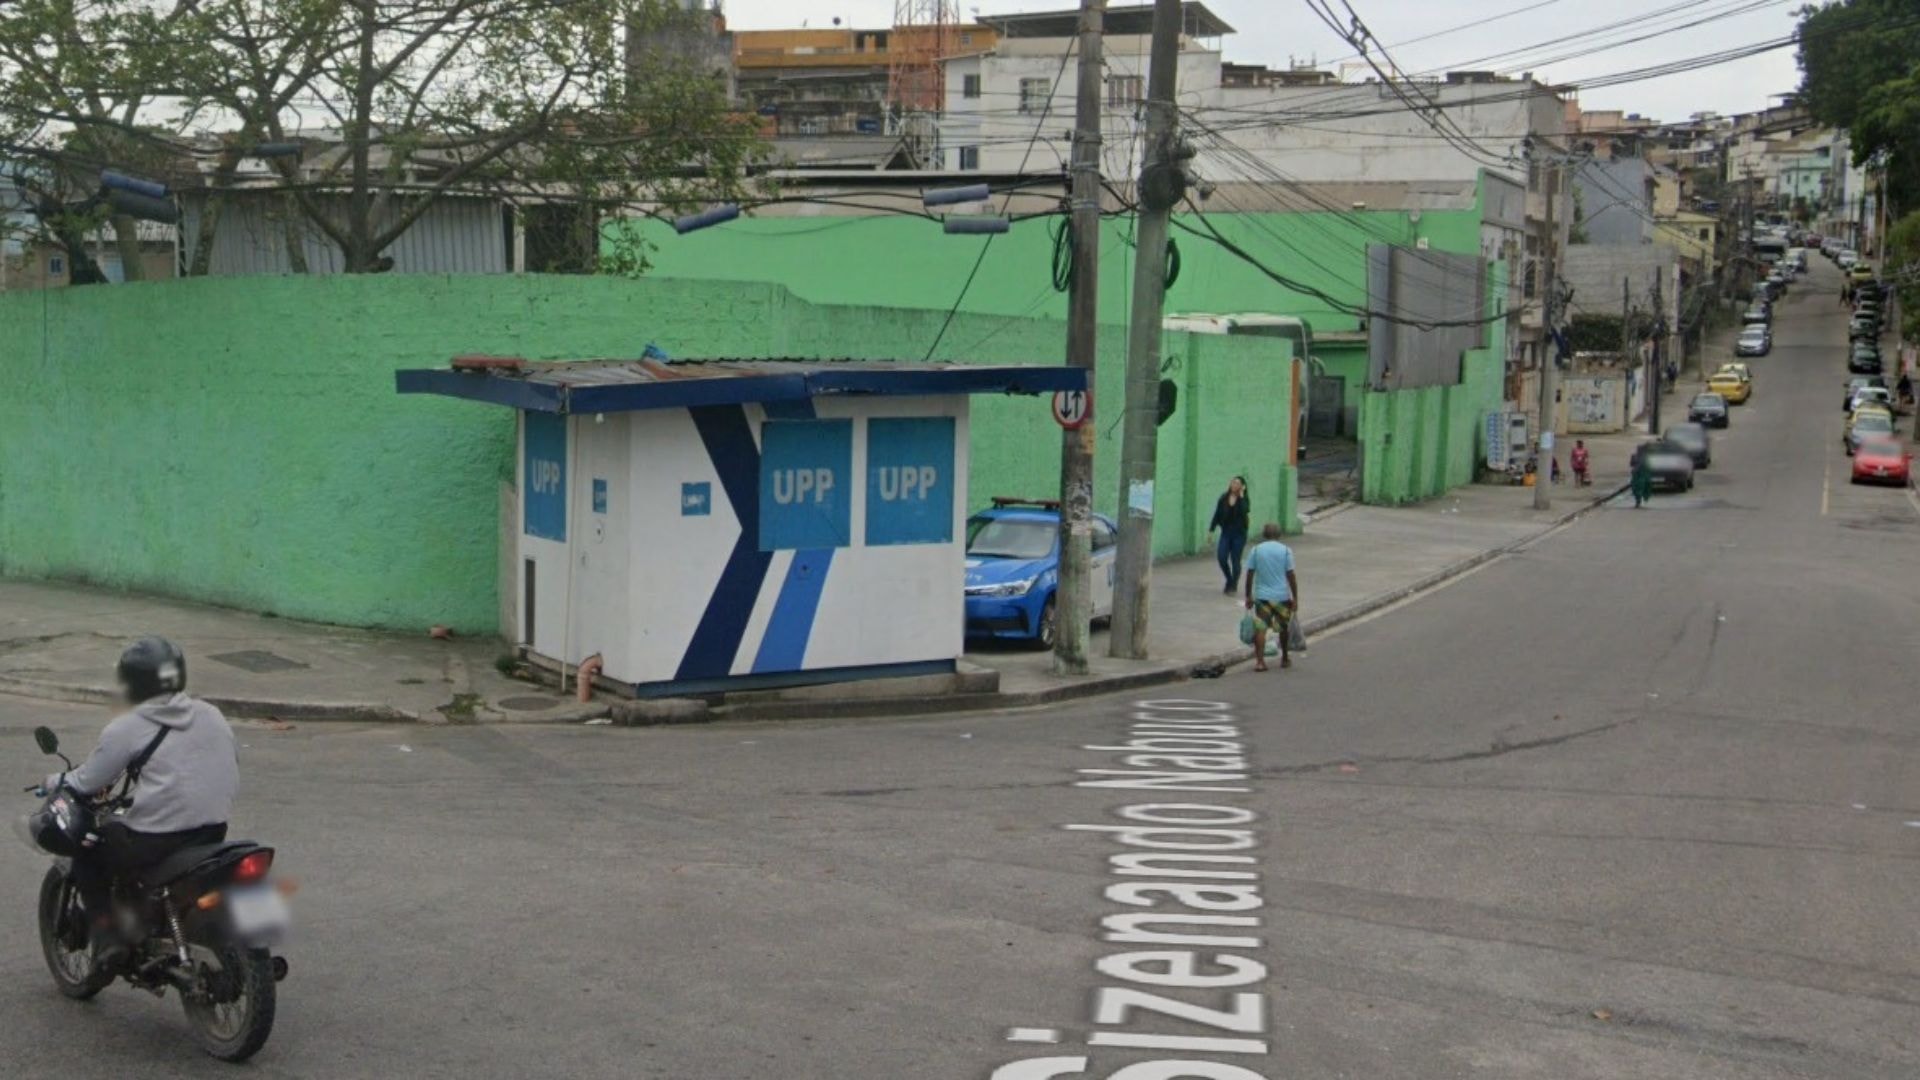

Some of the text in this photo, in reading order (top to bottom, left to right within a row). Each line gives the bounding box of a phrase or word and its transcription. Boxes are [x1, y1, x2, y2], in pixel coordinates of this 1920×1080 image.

[532, 458, 560, 496] UPP
[773, 468, 833, 504] UPP
[879, 466, 936, 501] UPP
